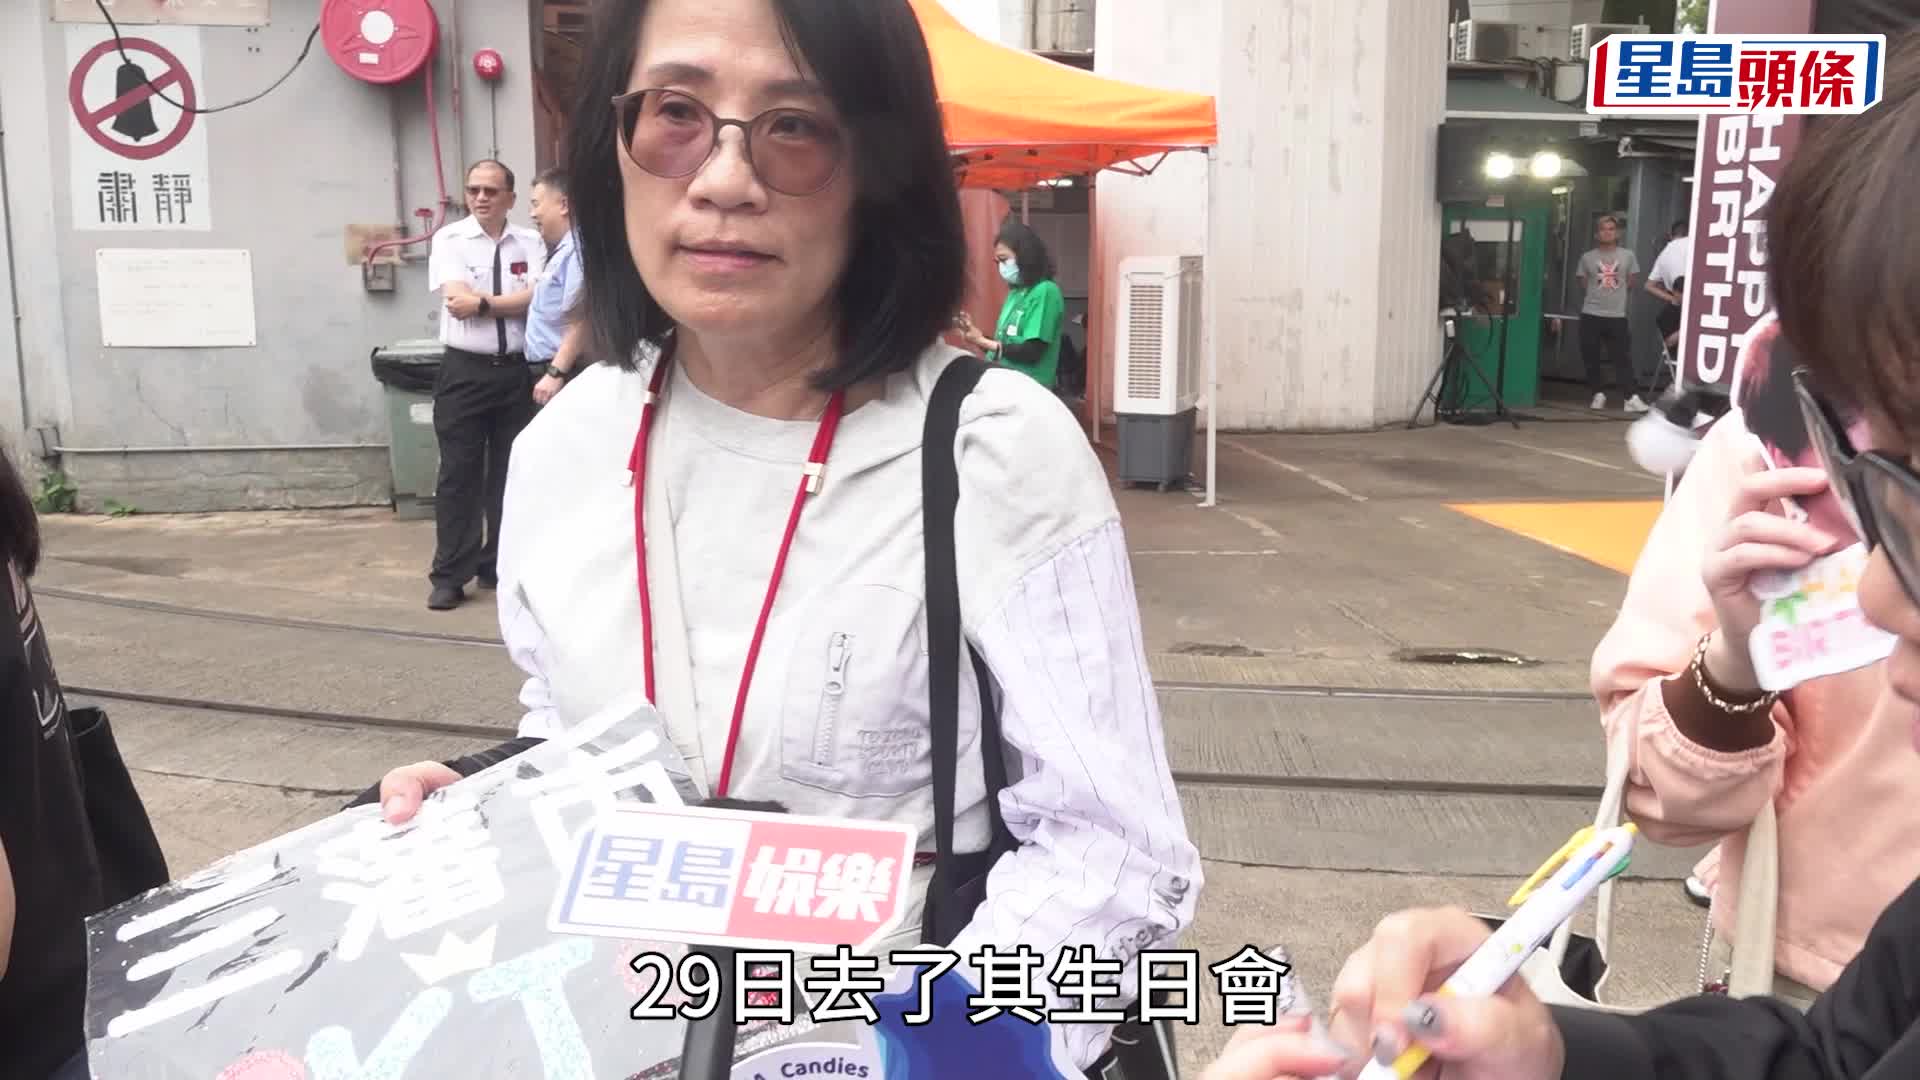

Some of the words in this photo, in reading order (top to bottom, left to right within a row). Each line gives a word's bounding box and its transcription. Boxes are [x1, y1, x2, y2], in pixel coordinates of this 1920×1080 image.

[97, 171, 192, 223] 肅靜
[1731, 114, 1784, 347] HAPP
[584, 834, 897, 922] 星島娛樂
[780, 1057, 869, 1078] Candies
